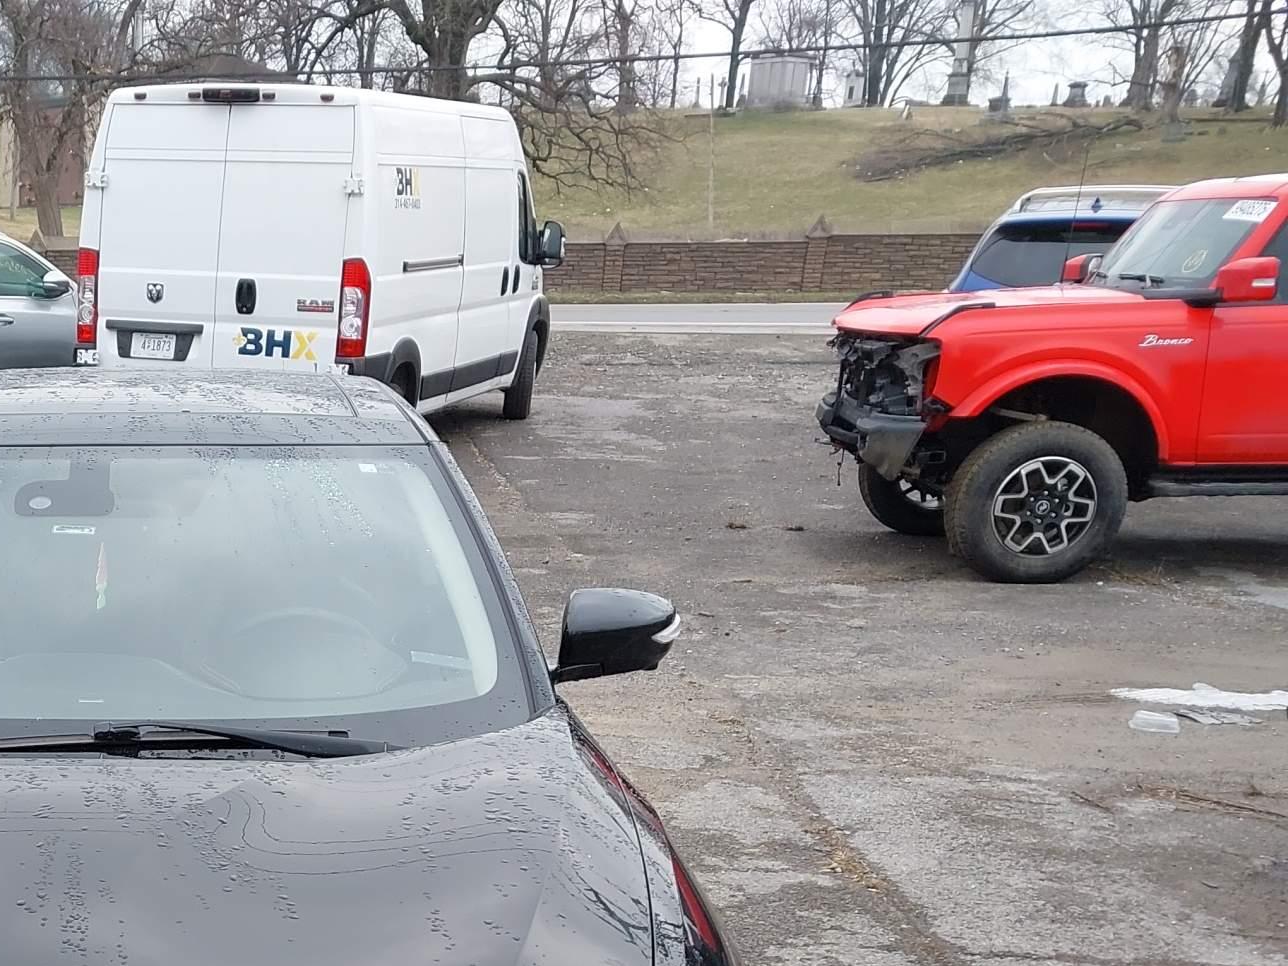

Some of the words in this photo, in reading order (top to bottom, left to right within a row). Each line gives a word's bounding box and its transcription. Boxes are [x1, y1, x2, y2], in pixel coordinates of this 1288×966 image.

[396, 168, 421, 196] BHX
[297, 298, 334, 306] RAM
[237, 326, 318, 361] BHX
[1138, 334, 1194, 347] Bronco
